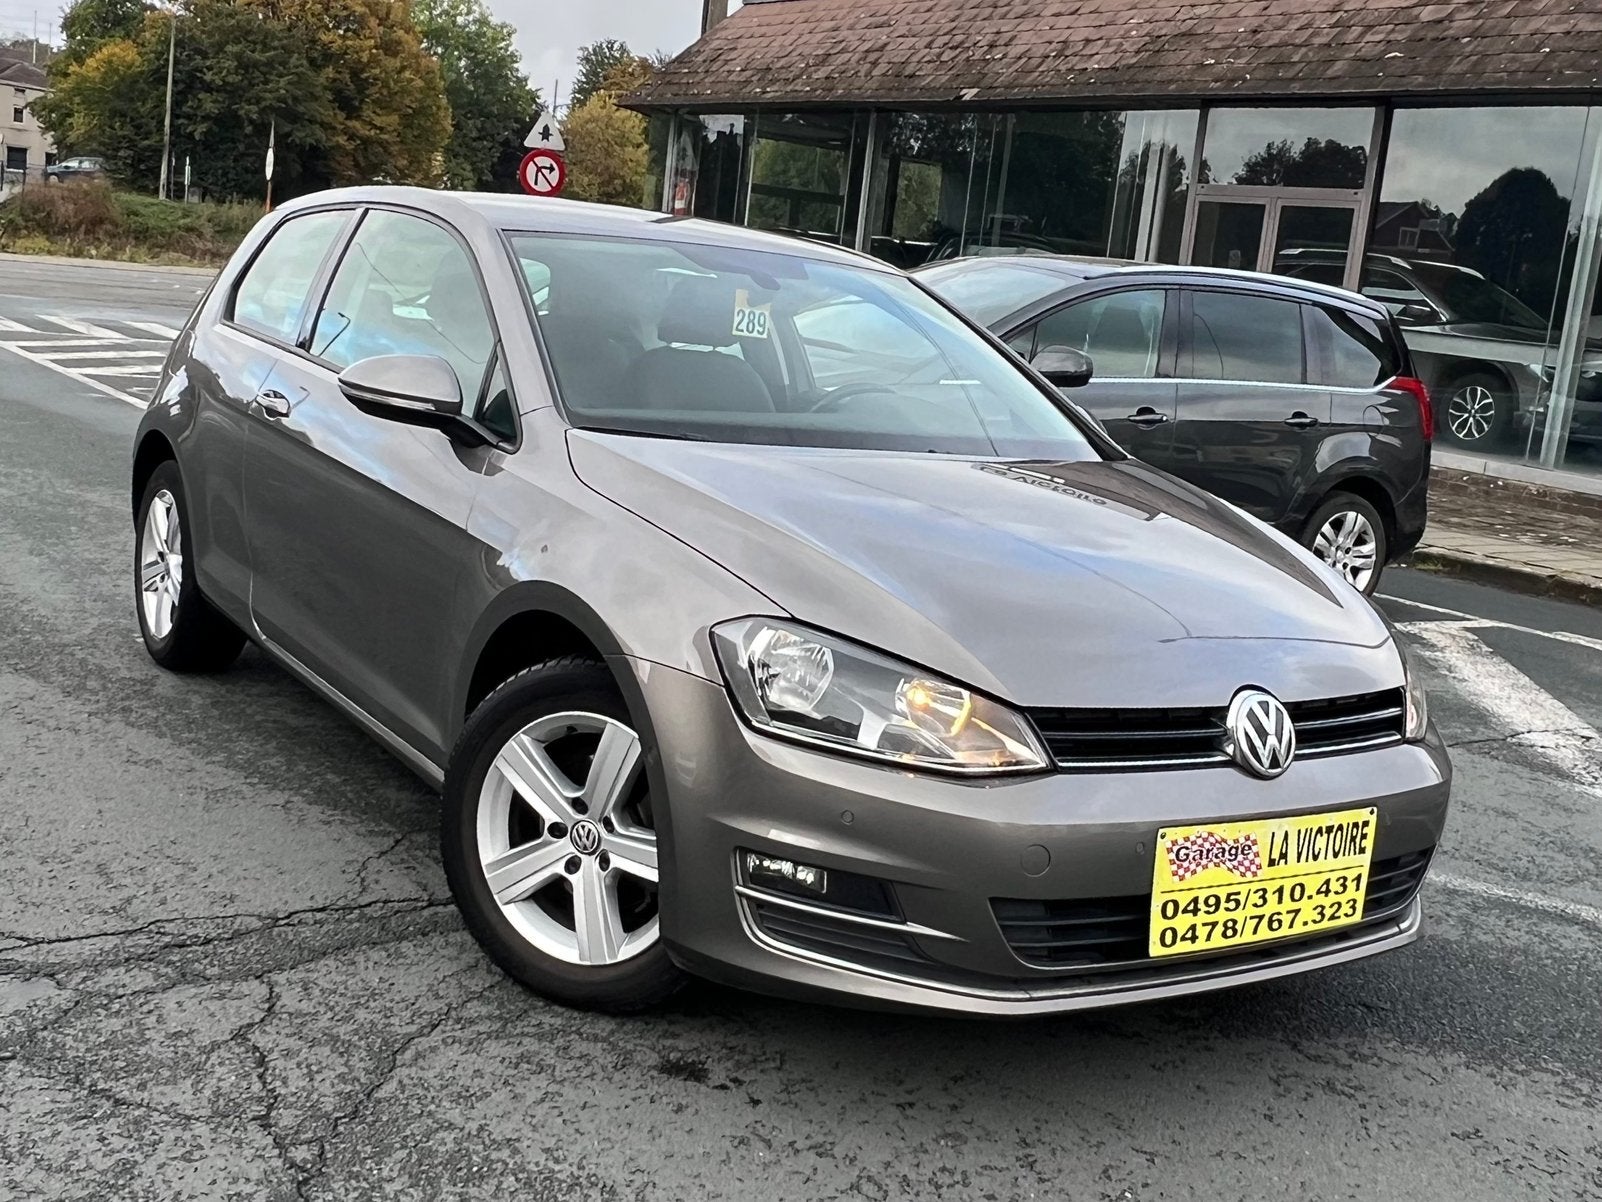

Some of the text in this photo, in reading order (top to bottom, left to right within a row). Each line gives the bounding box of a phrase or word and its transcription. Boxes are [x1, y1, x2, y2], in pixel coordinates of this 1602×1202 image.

[735, 308, 766, 335] 289
[1236, 692, 1296, 775] VW
[1175, 820, 1370, 867] Garage LA VICTOIRE
[1160, 873, 1363, 921] 0495/310.431
[1159, 898, 1358, 948] 0478/767.323
